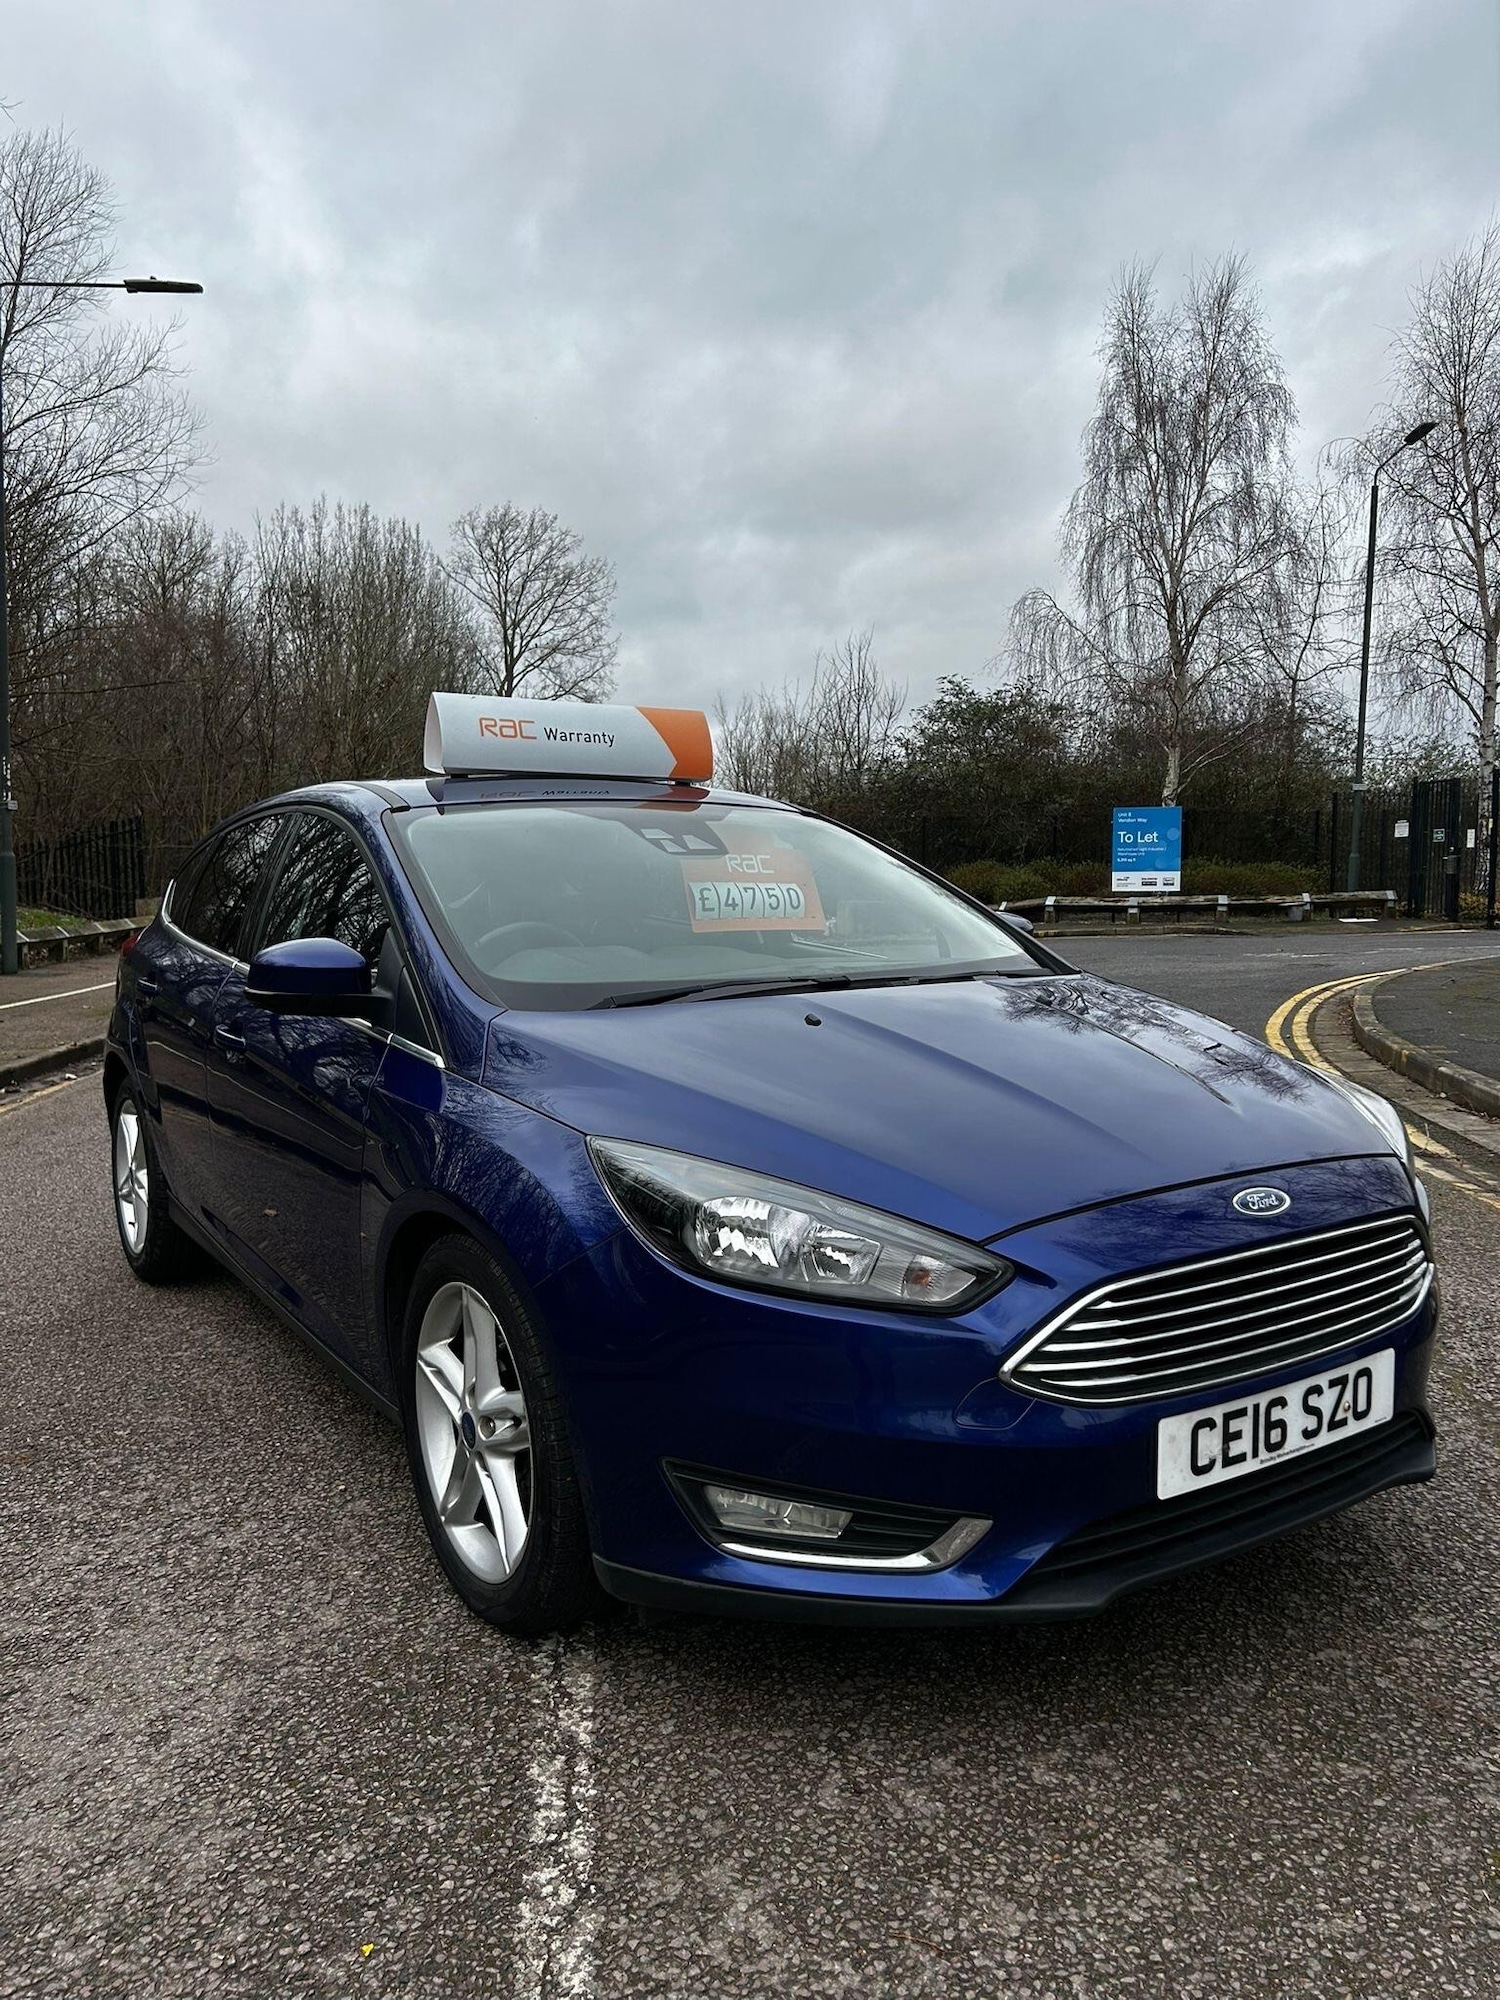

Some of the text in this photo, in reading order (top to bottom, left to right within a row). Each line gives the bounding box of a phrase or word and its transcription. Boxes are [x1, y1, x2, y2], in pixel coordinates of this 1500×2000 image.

[544, 727, 615, 748] Warranty
[1117, 831, 1159, 843] To Let
[1246, 1192, 1279, 1210] Ford
[1190, 1366, 1373, 1477] CE16 SZO
